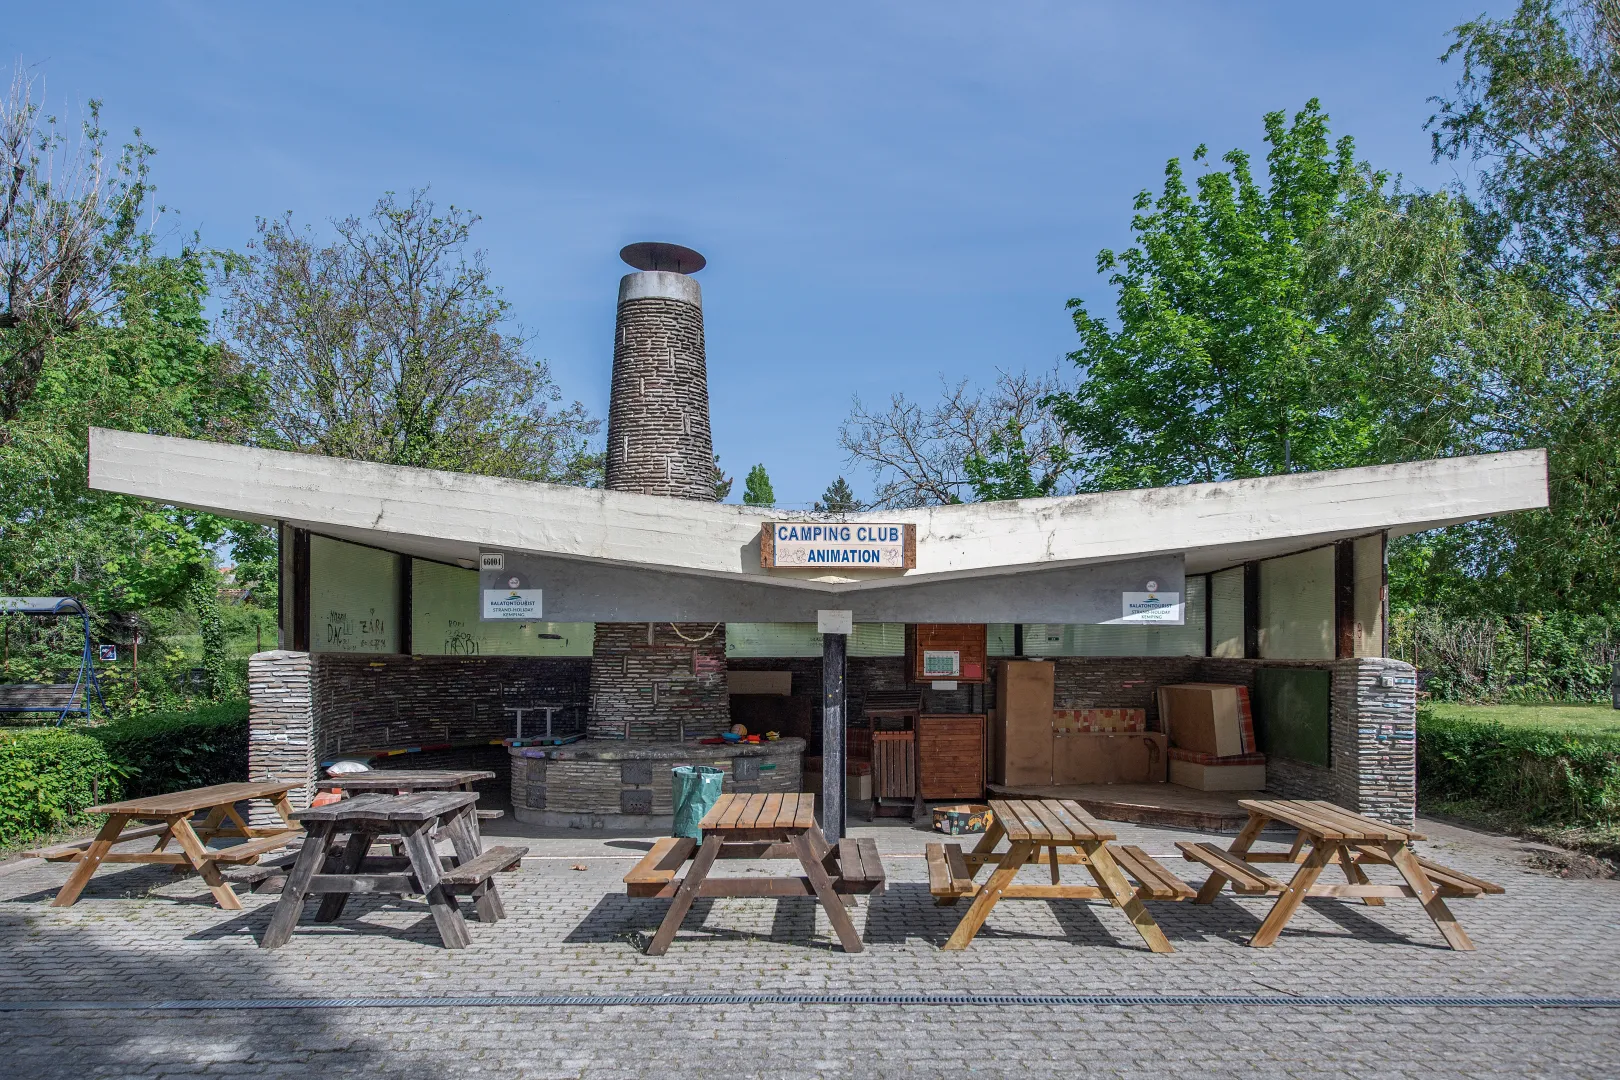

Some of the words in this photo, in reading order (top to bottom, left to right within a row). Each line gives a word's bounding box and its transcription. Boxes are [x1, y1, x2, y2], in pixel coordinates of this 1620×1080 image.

[778, 526, 851, 542] CAMPING
[857, 526, 899, 542] CLUB
[807, 549, 880, 563] ANIMATION
